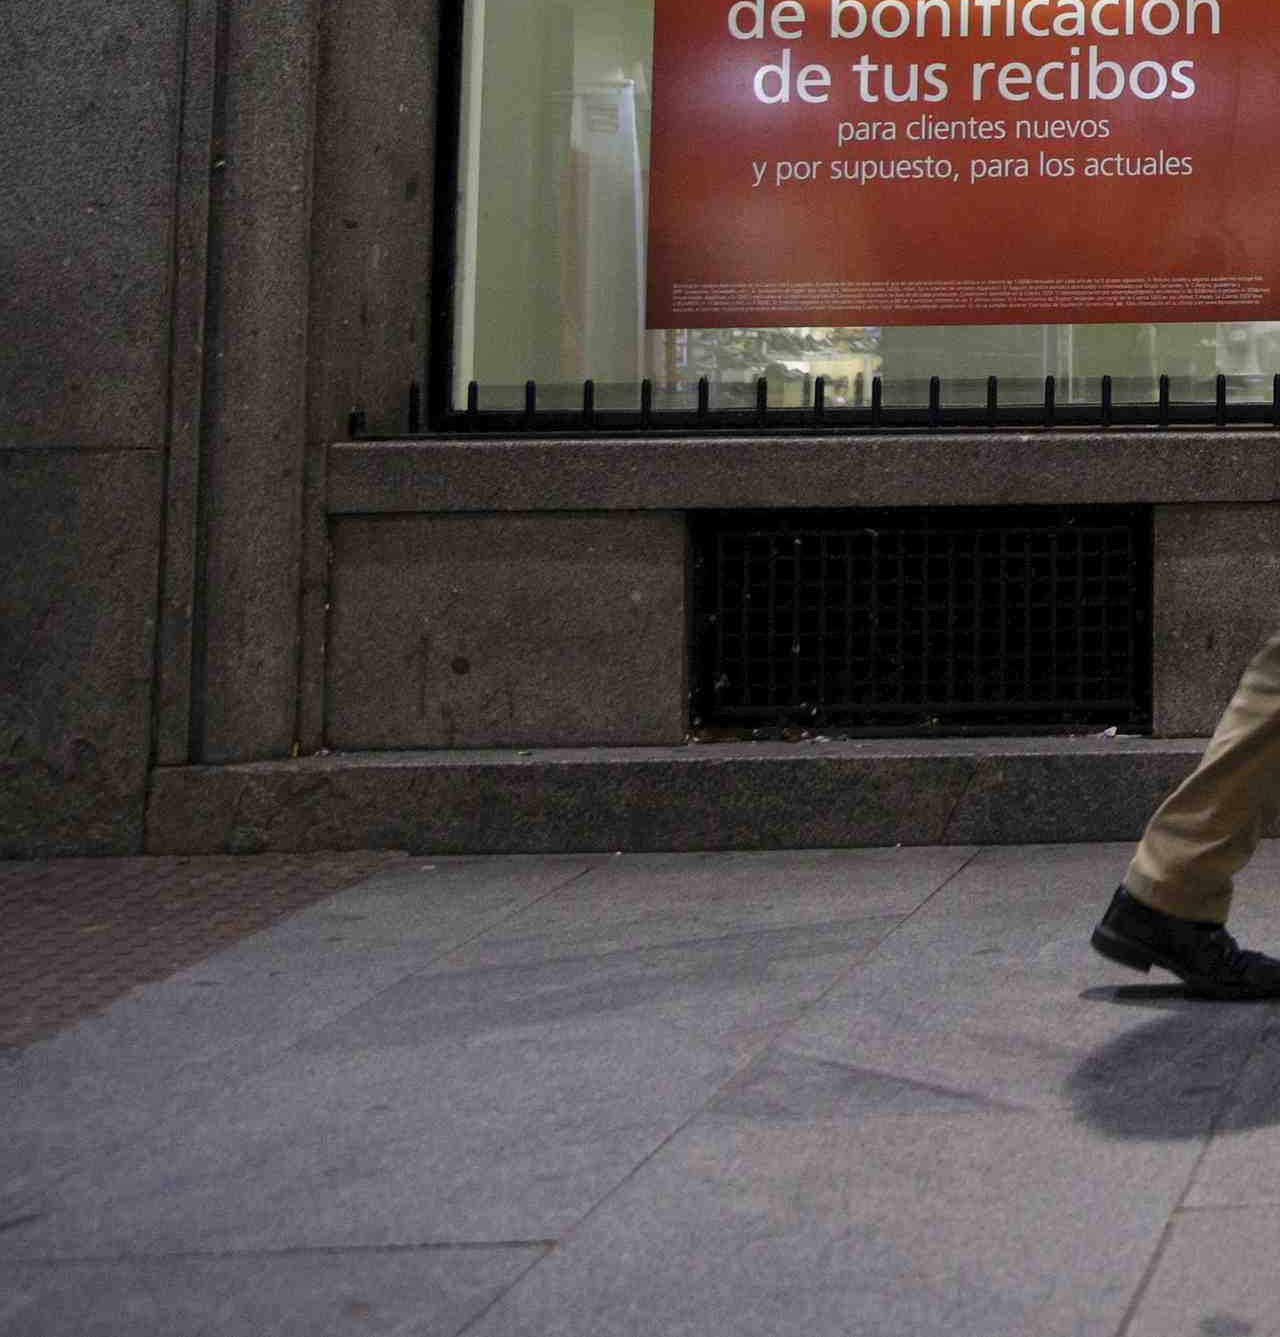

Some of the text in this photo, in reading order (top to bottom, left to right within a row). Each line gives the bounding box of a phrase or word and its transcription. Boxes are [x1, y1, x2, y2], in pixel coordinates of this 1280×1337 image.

[753, 45, 1197, 103] de tus recibos
[837, 114, 1110, 147] para clientes nuevos
[752, 150, 1193, 186] y por supuesto, para los actuales
